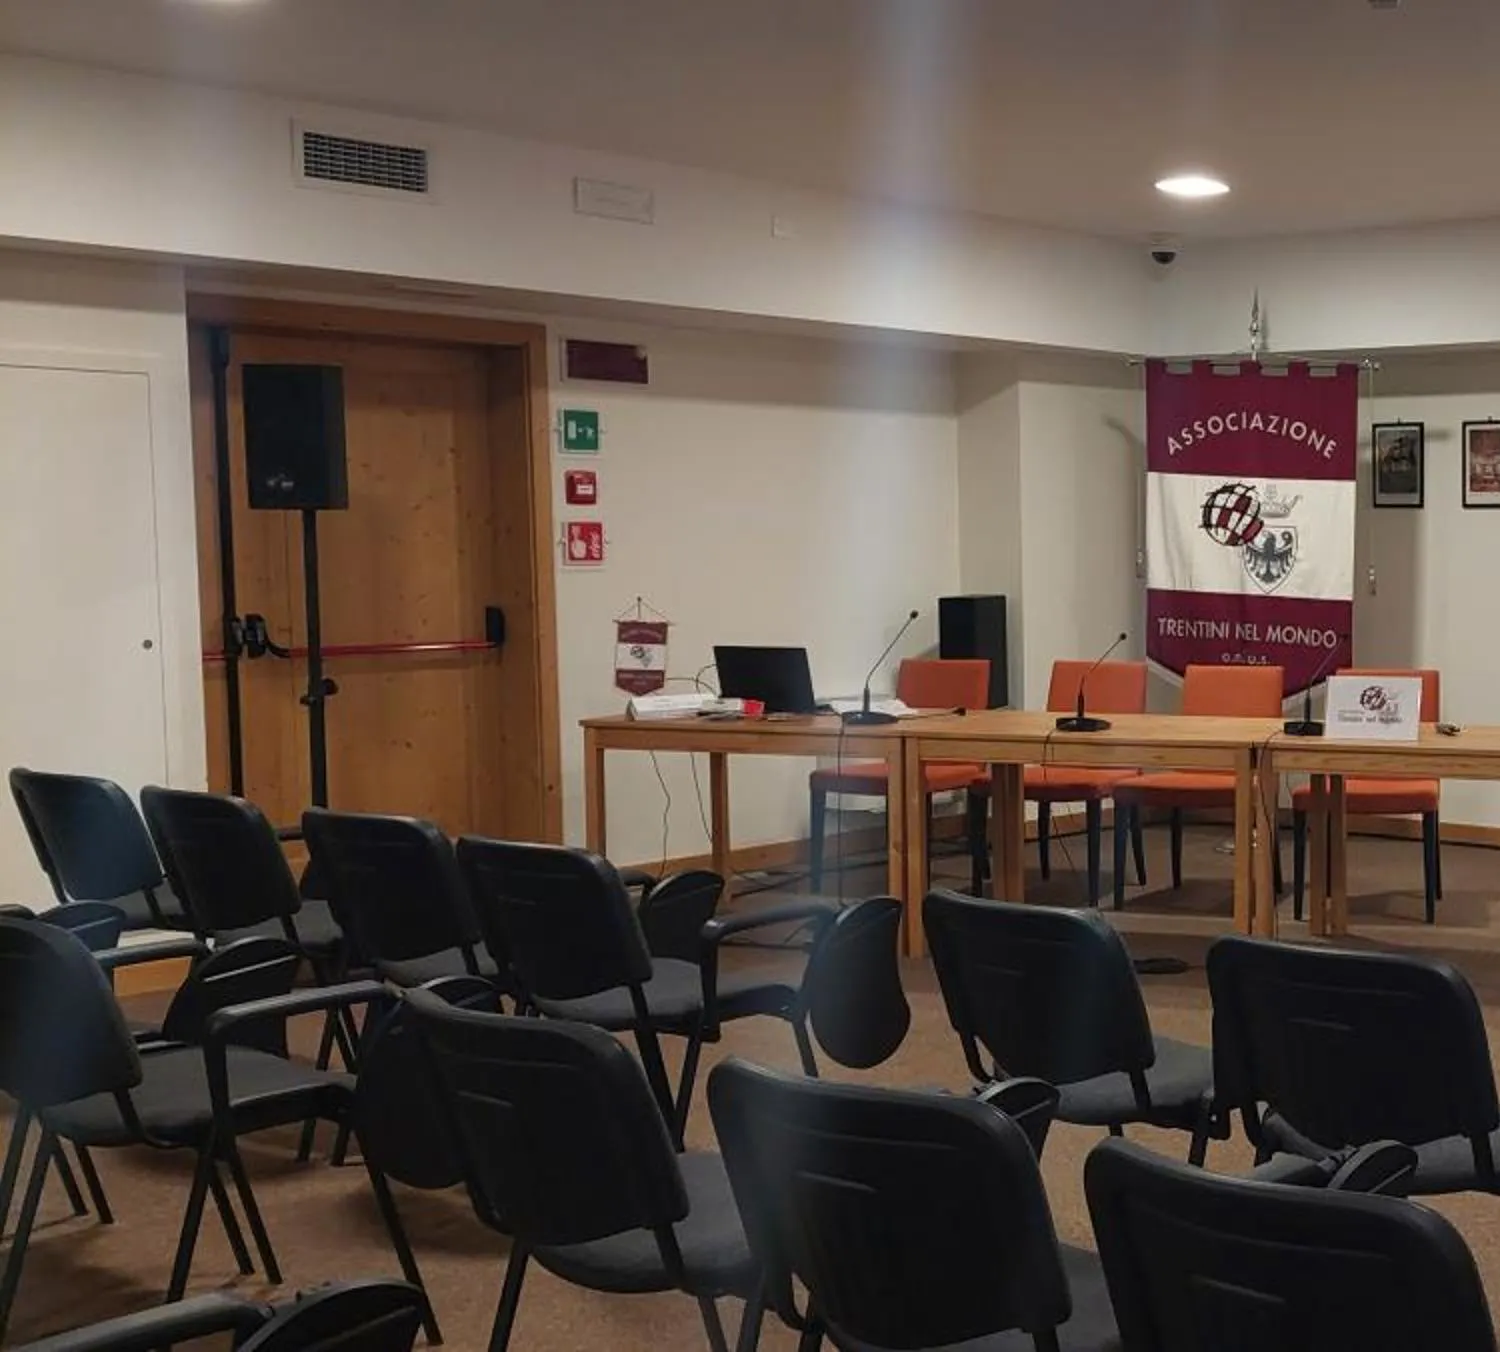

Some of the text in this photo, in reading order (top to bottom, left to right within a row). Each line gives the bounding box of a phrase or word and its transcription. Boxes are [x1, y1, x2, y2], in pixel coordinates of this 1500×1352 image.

[1167, 411, 1337, 459] ASSOCIAZIONE
[1157, 617, 1337, 649] TRENTINI NEL MONDO
